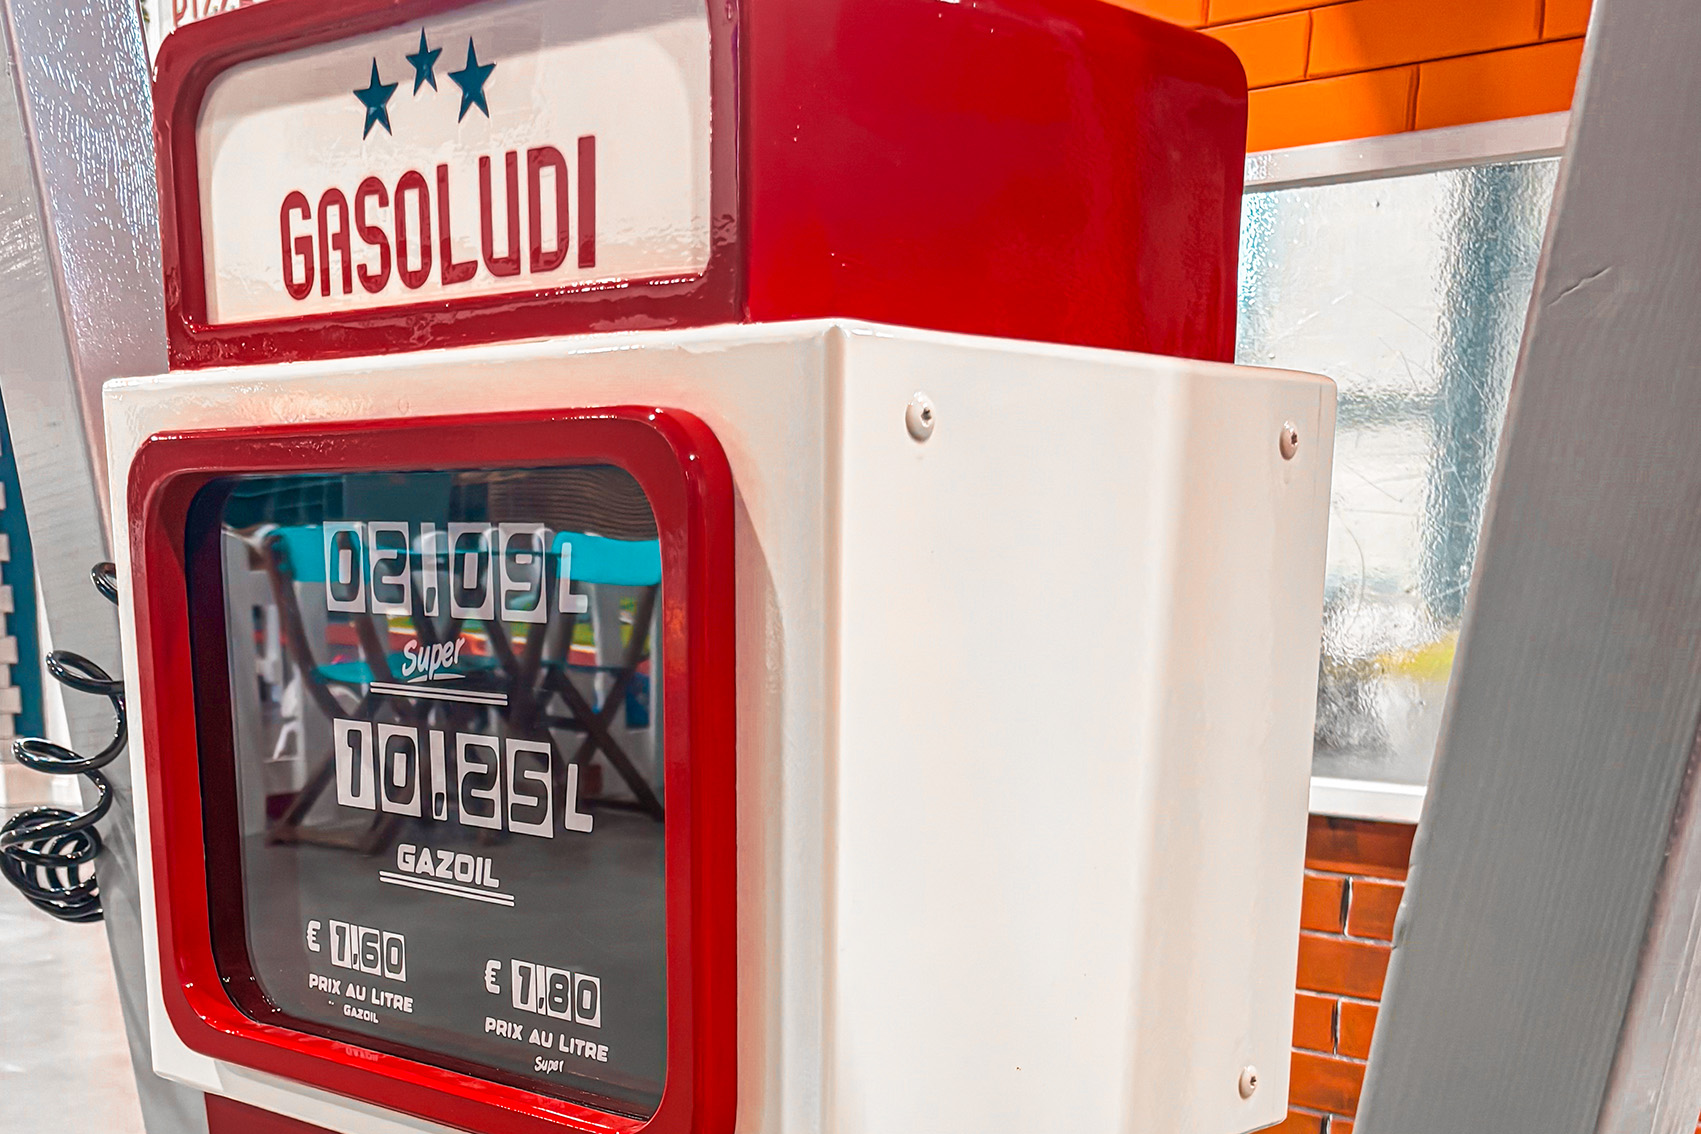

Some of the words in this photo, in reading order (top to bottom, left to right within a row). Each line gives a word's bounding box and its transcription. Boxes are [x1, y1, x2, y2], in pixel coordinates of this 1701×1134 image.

[280, 135, 596, 300] GASOLUDI
[559, 542, 588, 613] L
[402, 637, 466, 681] Super
[565, 763, 593, 832] L
[397, 843, 499, 888] GAZOIL
[307, 920, 321, 952] €
[308, 973, 341, 995] PRIX
[346, 983, 367, 1001] AU
[371, 987, 414, 1013] LITRE
[484, 959, 501, 994] €
[343, 1004, 379, 1024] GAZOIL
[484, 1016, 523, 1041] PRIX
[528, 1028, 553, 1048] AU
[559, 1033, 609, 1062] LITRE
[534, 1055, 564, 1074] Super
